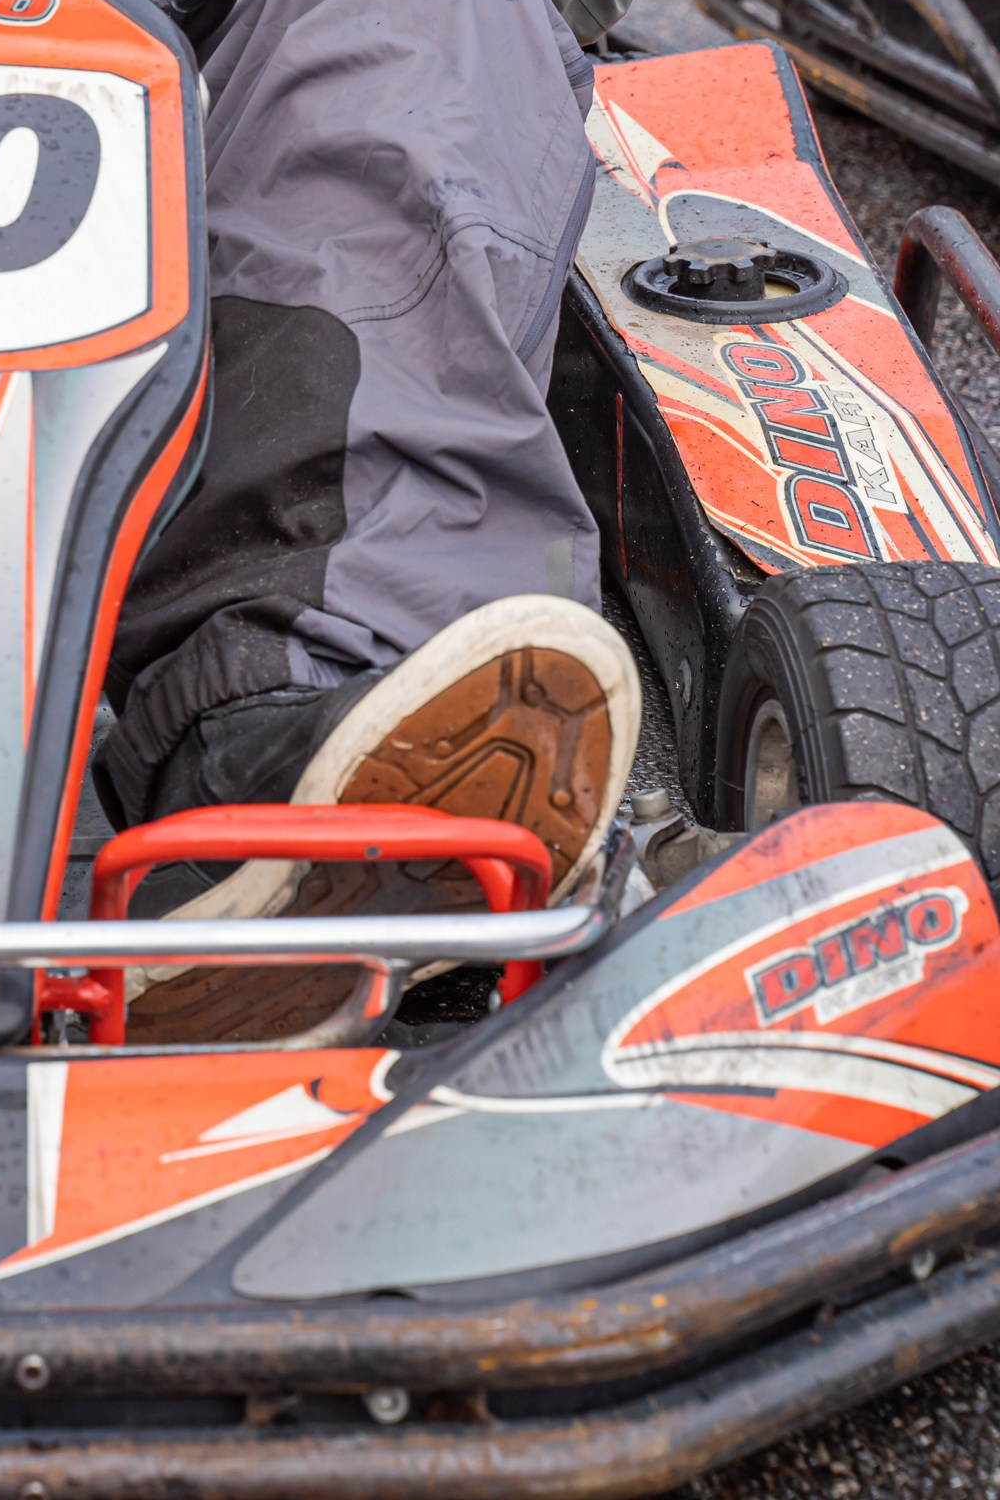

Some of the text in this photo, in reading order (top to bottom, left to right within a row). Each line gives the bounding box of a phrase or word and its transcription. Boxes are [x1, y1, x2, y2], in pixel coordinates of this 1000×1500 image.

[720, 341, 883, 562] DINO
[819, 383, 898, 505] KART
[752, 893, 958, 1019] DINO
